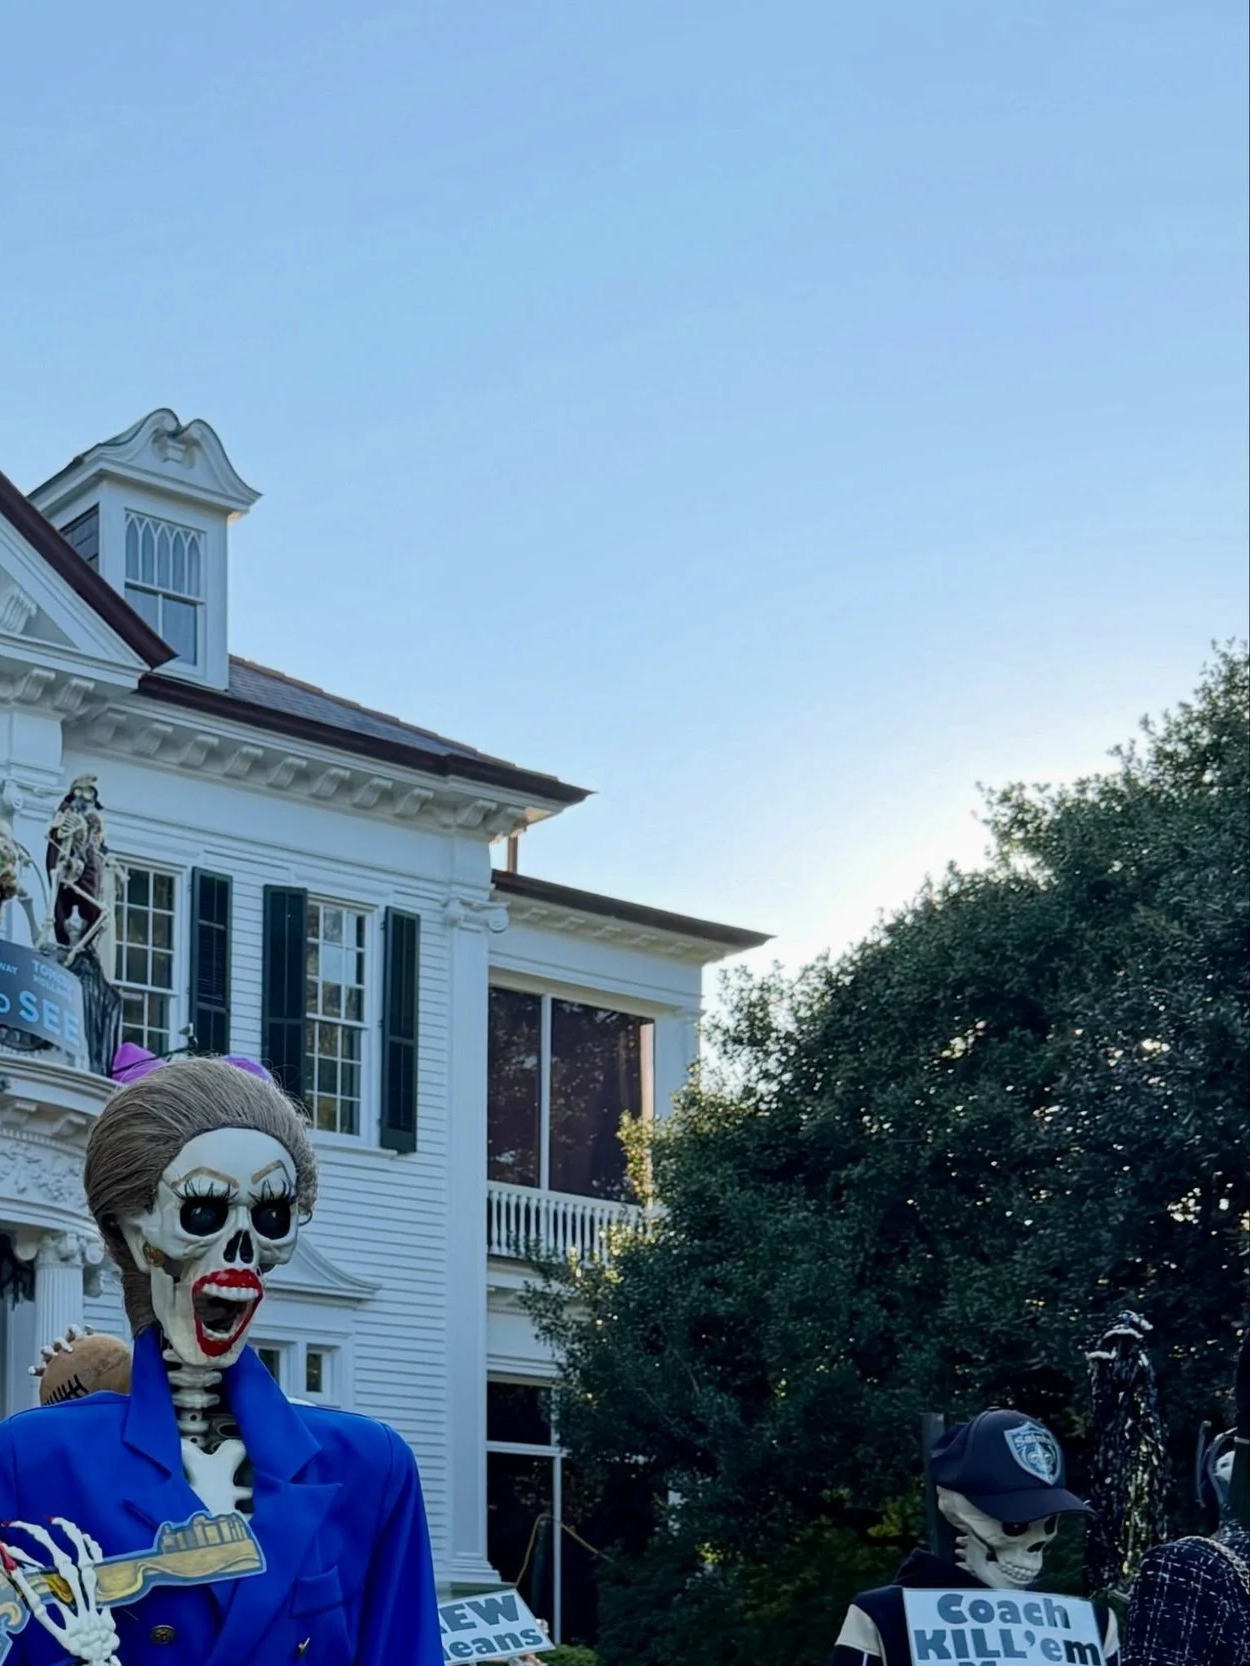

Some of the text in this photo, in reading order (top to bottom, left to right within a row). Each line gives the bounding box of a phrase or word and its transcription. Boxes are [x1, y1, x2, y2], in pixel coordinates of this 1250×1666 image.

[19, 990, 80, 1048] SEE
[440, 1595, 519, 1633] EW
[937, 1593, 1070, 1629] Coach
[444, 1629, 543, 1660] eans
[913, 1628, 1101, 1666] KILL'em
